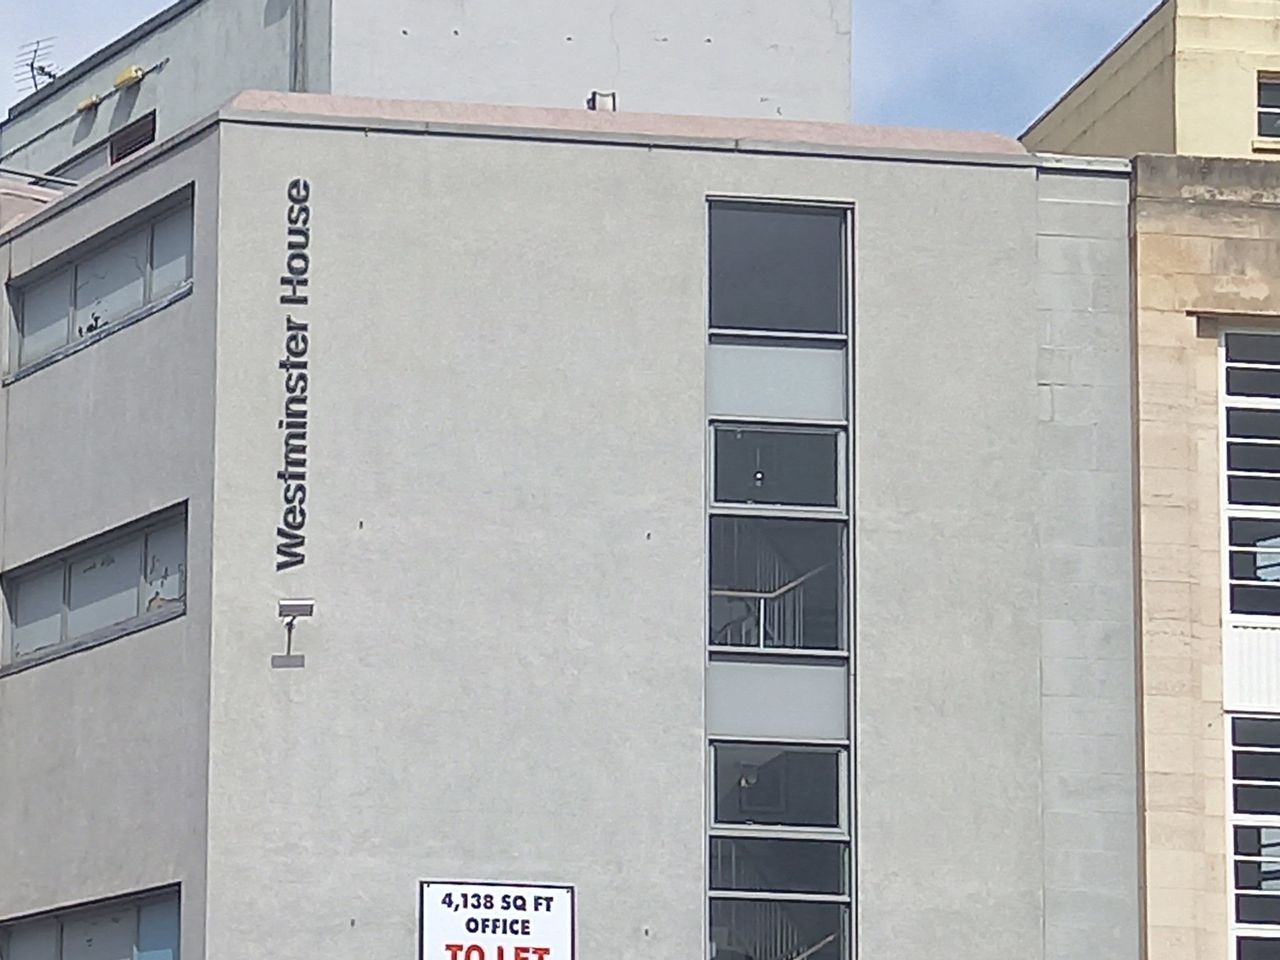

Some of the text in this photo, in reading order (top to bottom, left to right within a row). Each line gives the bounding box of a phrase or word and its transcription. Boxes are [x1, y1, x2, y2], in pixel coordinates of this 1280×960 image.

[276, 178, 311, 572] Westminster House
[441, 893, 554, 912] 4,138 SQ FT
[465, 917, 531, 935] OFFICE
